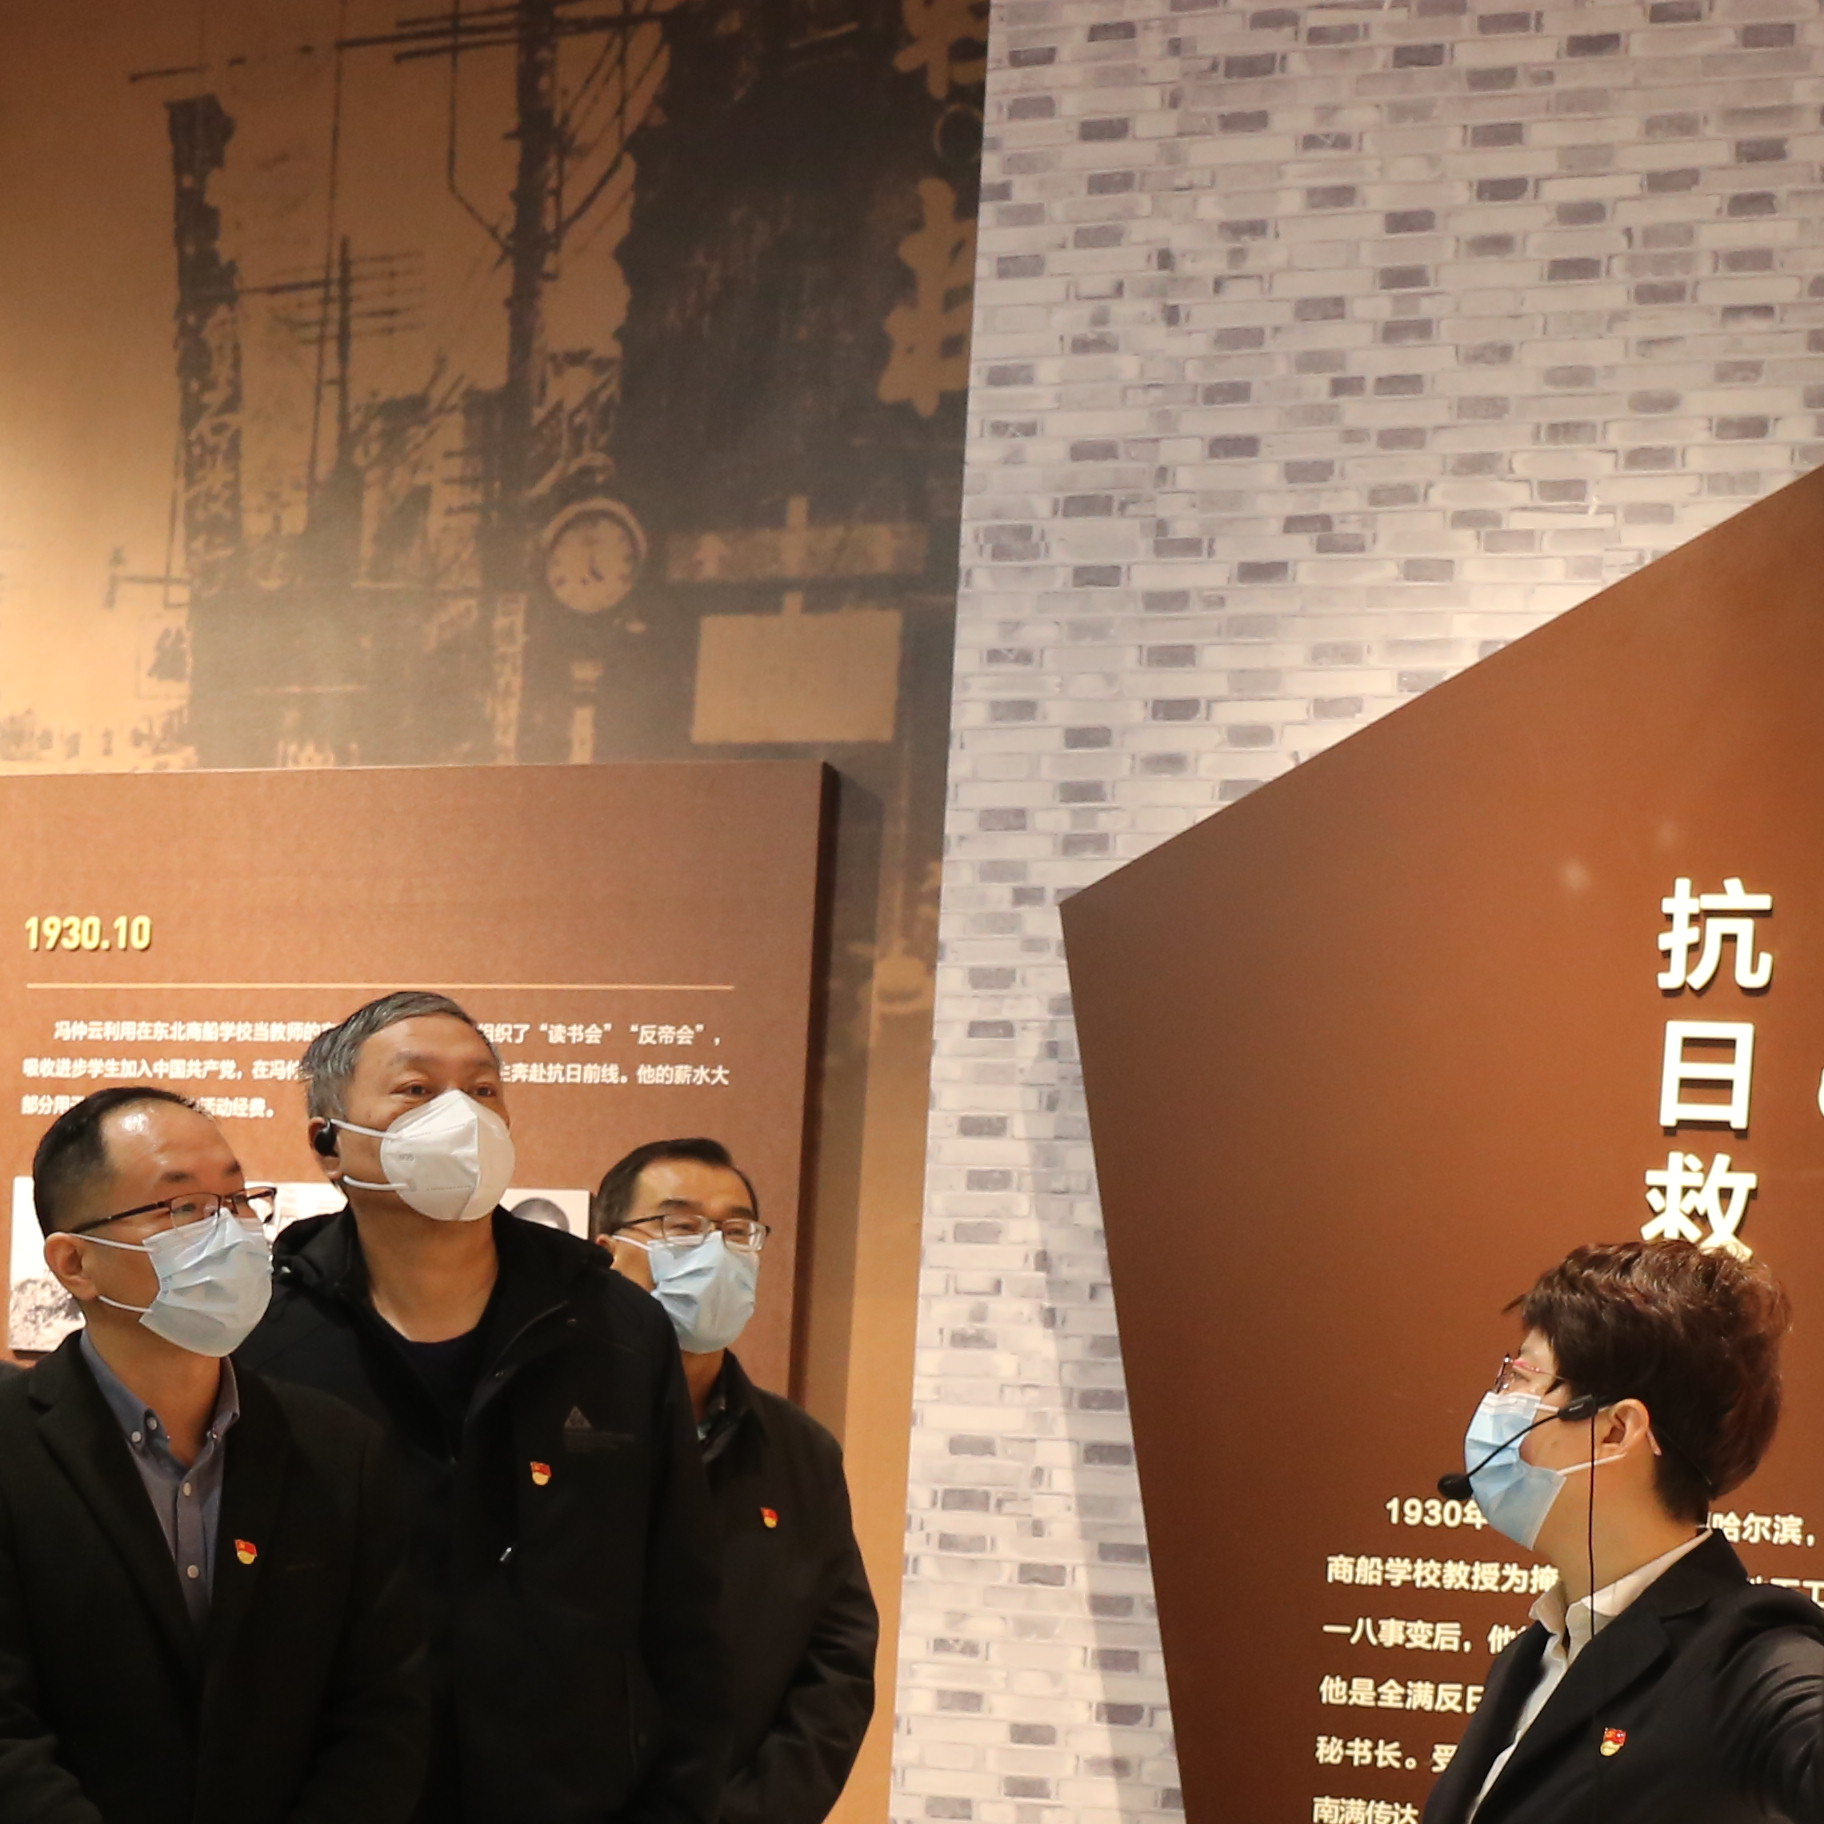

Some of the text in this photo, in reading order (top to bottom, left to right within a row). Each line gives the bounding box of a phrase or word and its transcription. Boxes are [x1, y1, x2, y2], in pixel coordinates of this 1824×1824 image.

[24, 915, 153, 953] 1930.10
[1640, 877, 1774, 1262] 抗日救
[1385, 1497, 1488, 1530] 1930年
[1327, 1554, 1559, 1594] 商船学校教授为掩
[1323, 1616, 1528, 1654] 一八事变后，他
